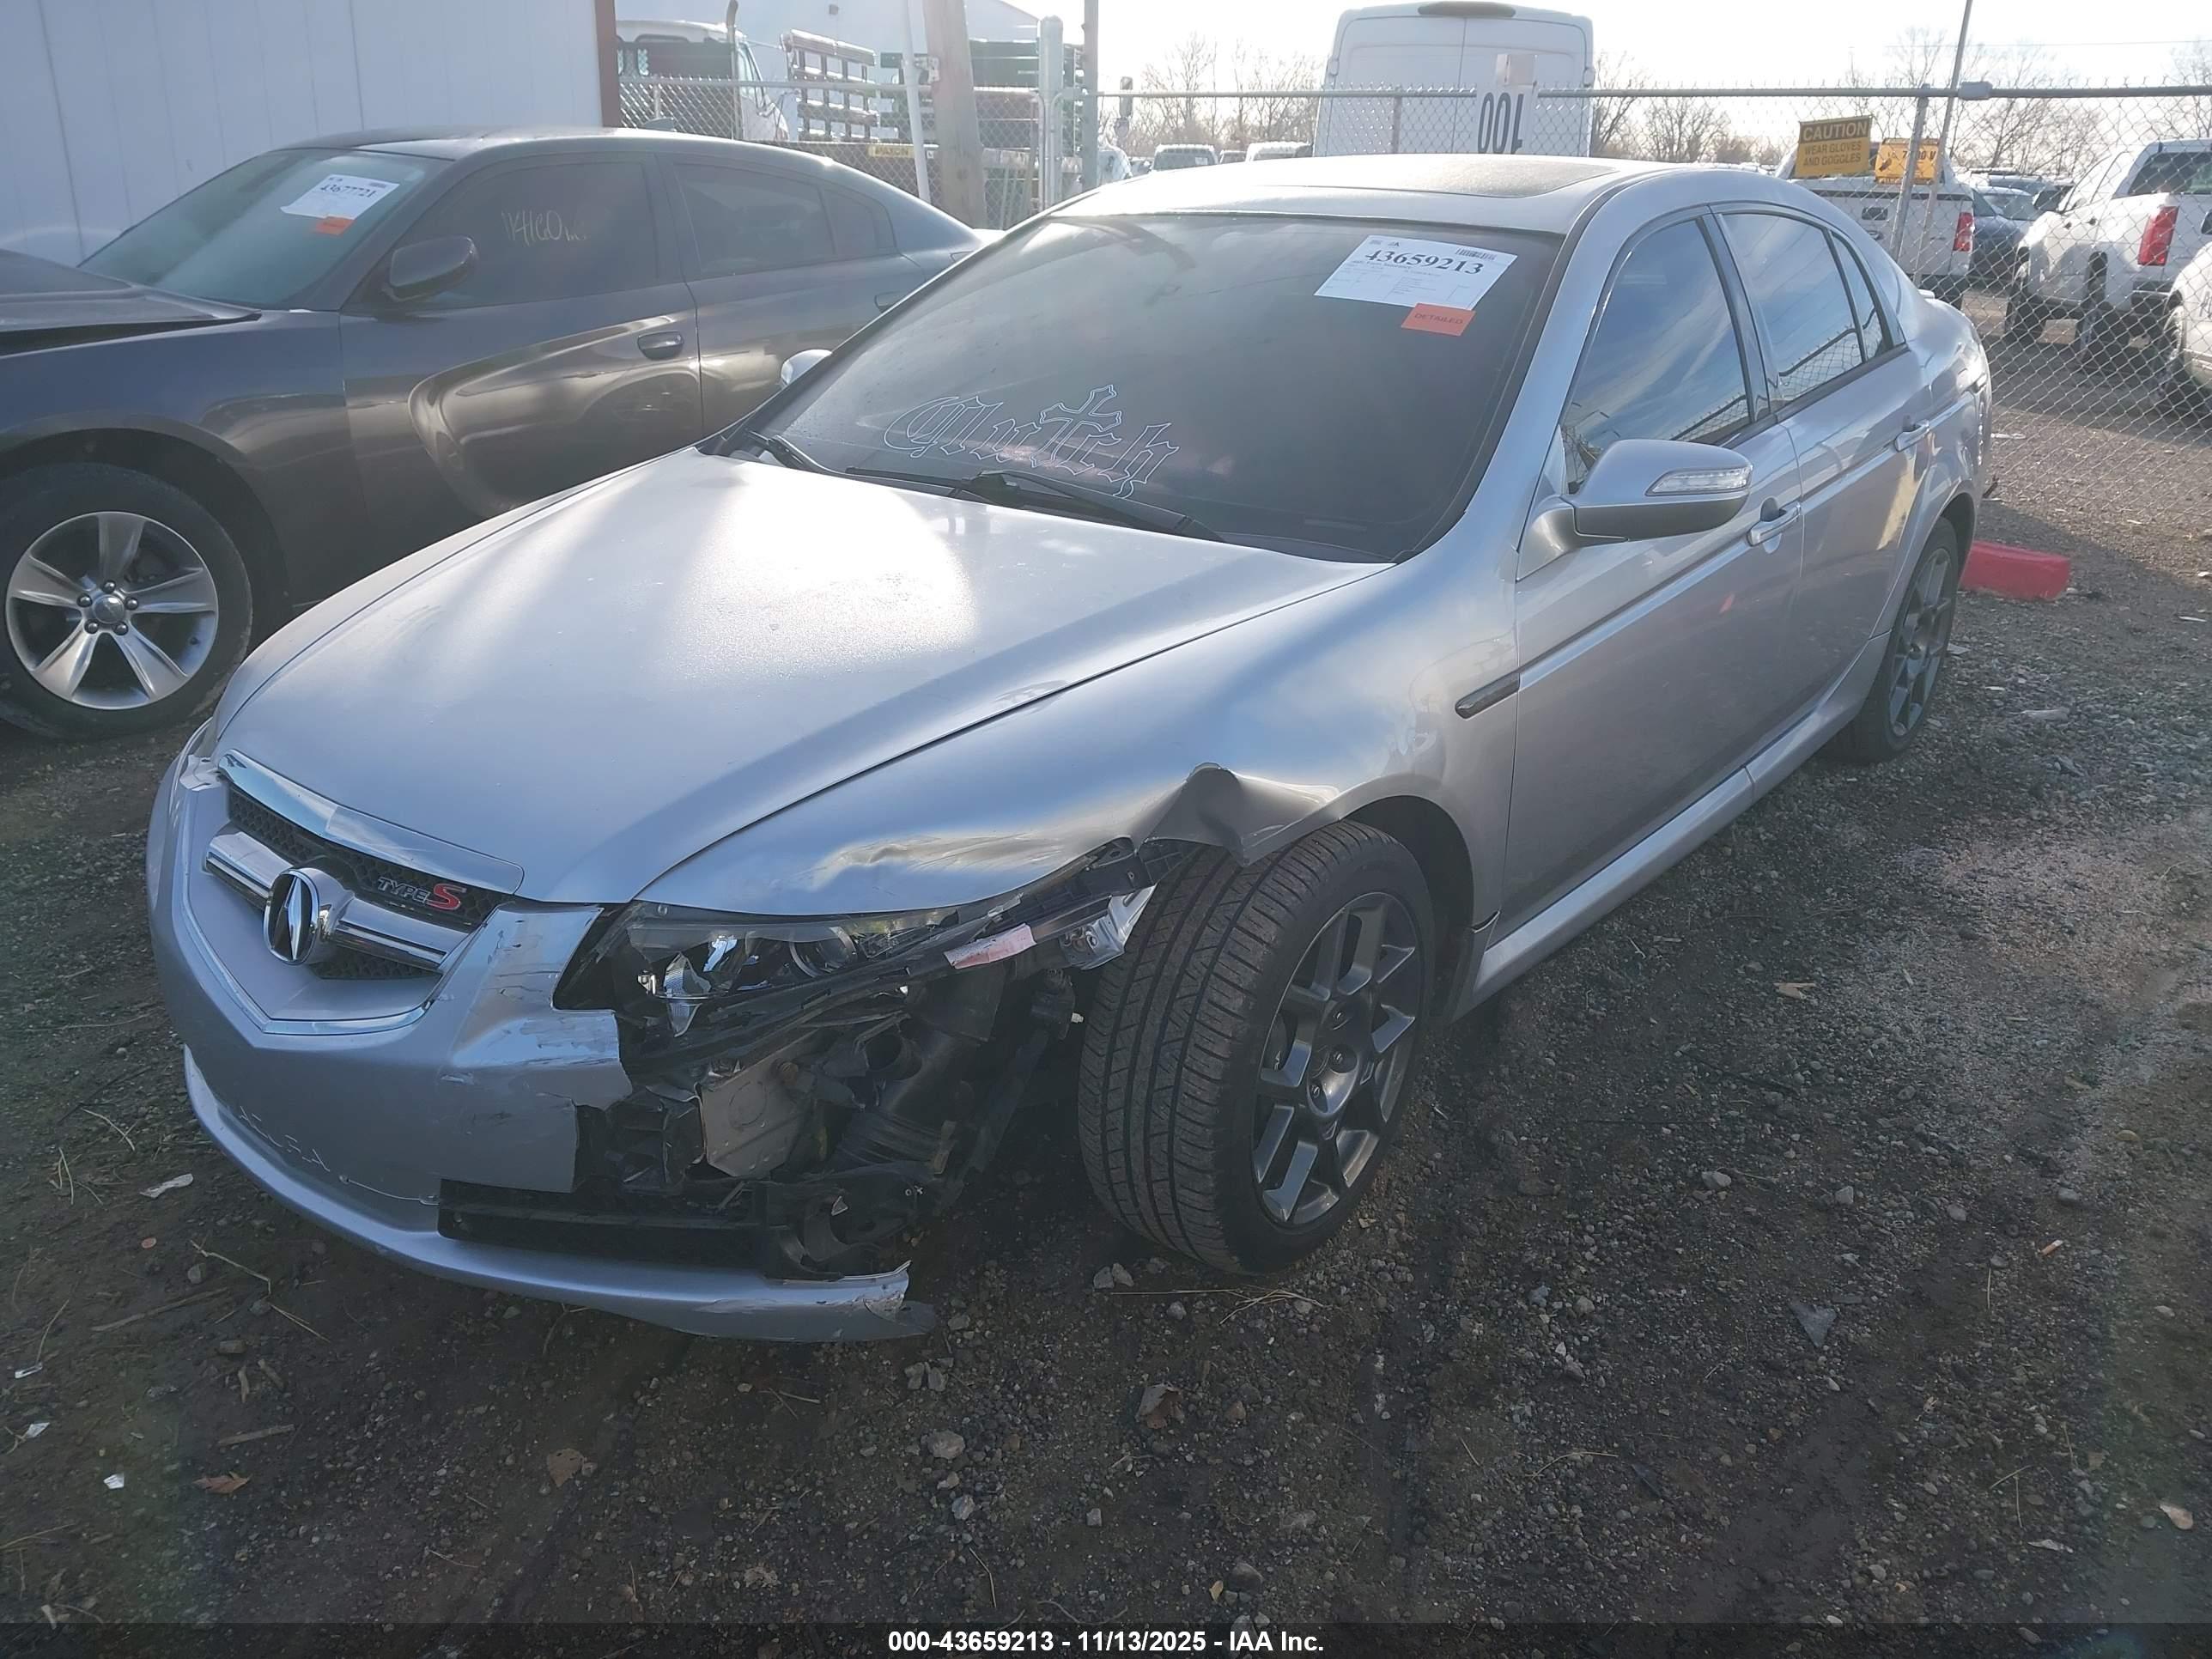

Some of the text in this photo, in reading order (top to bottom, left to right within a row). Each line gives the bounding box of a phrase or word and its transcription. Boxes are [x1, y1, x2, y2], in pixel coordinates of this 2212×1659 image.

[1803, 122, 1868, 142] CAUTION
[1805, 141, 1862, 156] WEAR GLOVES
[1803, 153, 1862, 167] AND GOGGLES
[1364, 249, 1484, 275] 43659213
[1413, 313, 1464, 325] DETAILED
[378, 876, 467, 910] TYPE S
